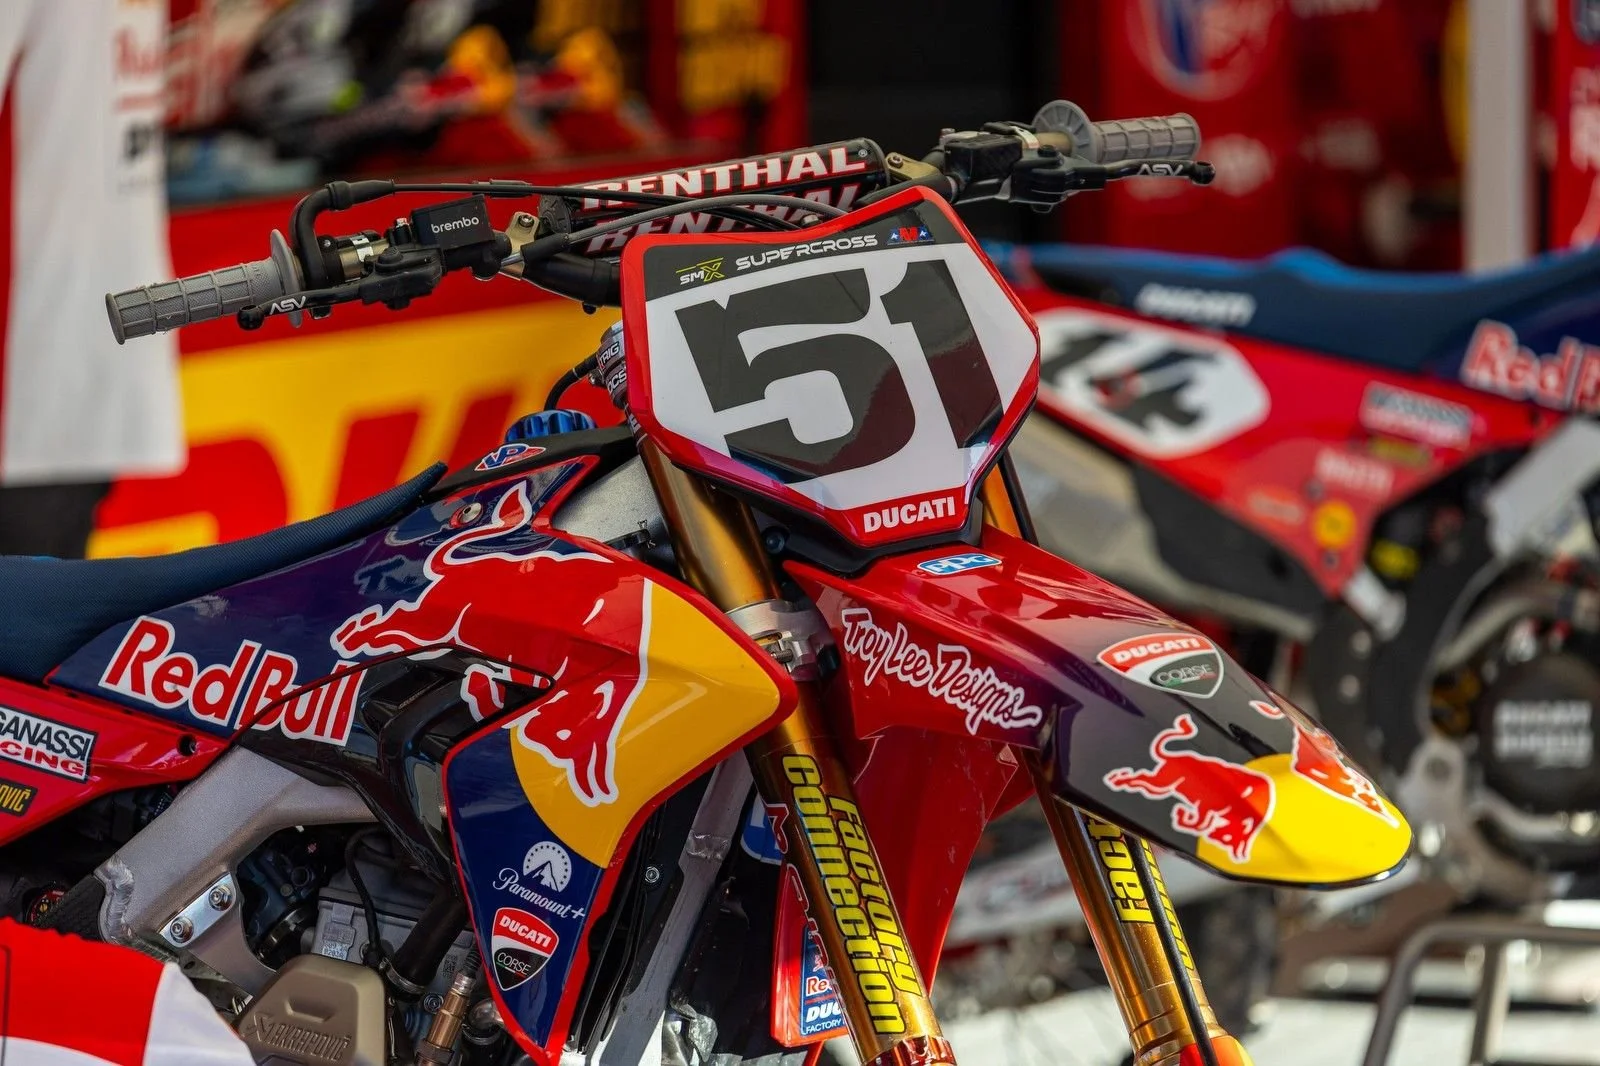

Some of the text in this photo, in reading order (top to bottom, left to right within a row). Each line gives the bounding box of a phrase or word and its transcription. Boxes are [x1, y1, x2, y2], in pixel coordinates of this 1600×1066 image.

[583, 147, 866, 211] RENTHAL
[1137, 163, 1183, 177] ASV
[431, 215, 480, 234] brembo
[679, 260, 726, 286] SMX
[735, 234, 878, 271] SUPERCROSS
[269, 296, 307, 316] ASV
[675, 258, 1001, 486] 51
[863, 496, 957, 533] DUCATI
[924, 554, 995, 574] PPG
[1111, 637, 1202, 664] DUCATI
[99, 615, 369, 747] Red Bull
[841, 608, 1043, 736] Troy Lee Designs
[1156, 663, 1213, 684] CORSE
[492, 867, 586, 920] Paramount+
[499, 914, 553, 949] DUCATI
[497, 952, 532, 977] CORSE
[804, 975, 833, 998] Re
[805, 1018, 841, 1035] FACTORY
